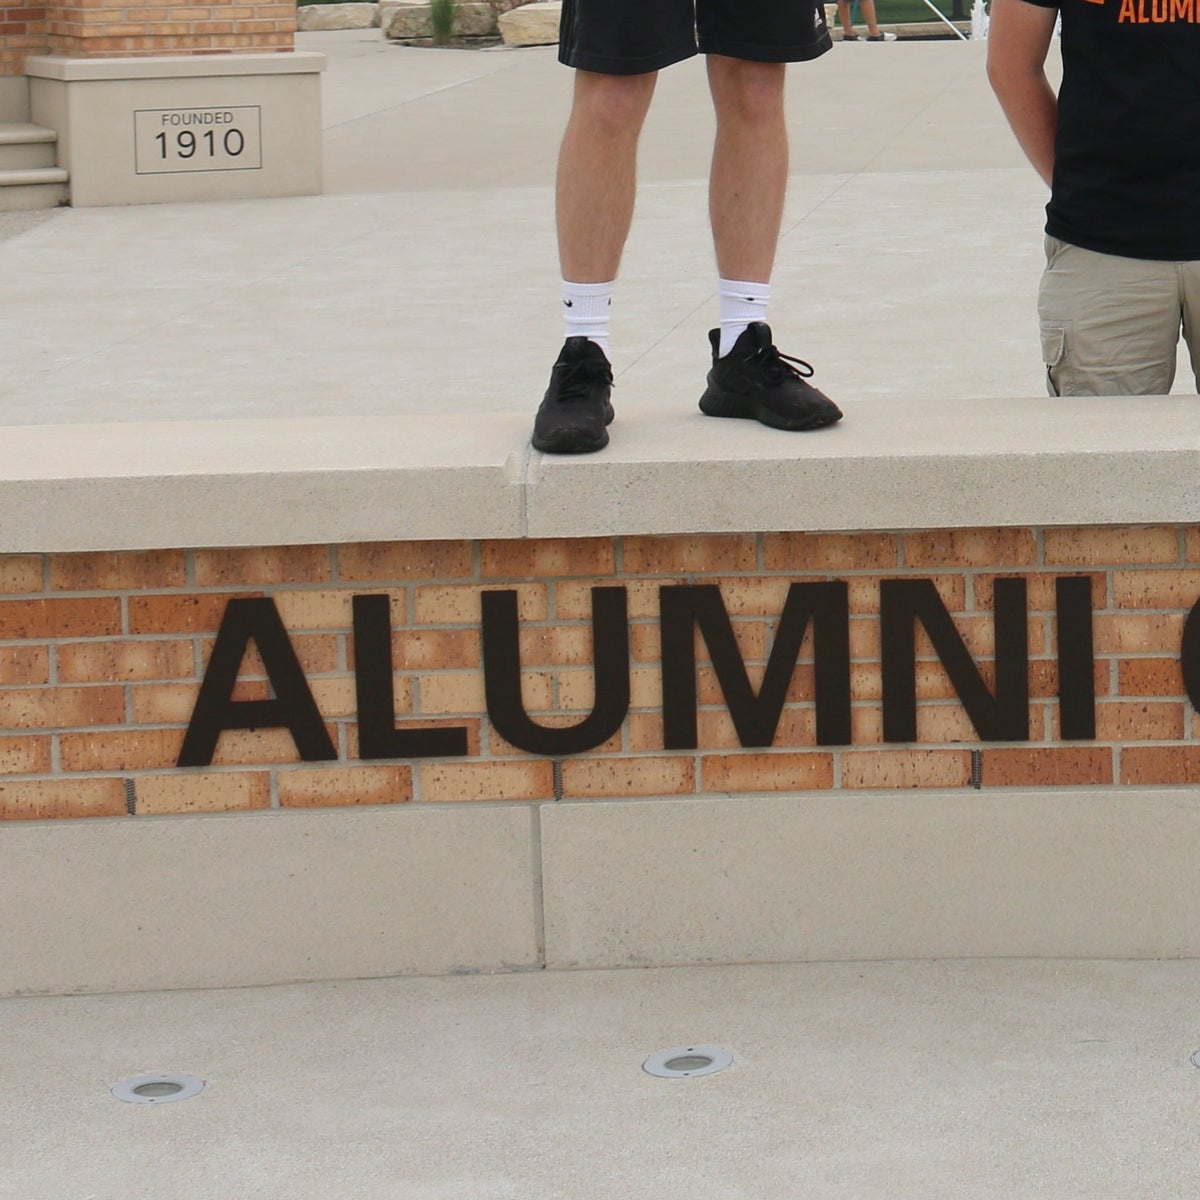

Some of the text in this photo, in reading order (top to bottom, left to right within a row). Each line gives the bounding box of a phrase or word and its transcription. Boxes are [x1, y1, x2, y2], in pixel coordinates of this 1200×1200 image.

[161, 112, 234, 126] FOUNDED
[155, 128, 245, 159] 1910
[176, 575, 1097, 767] ALUMNI
